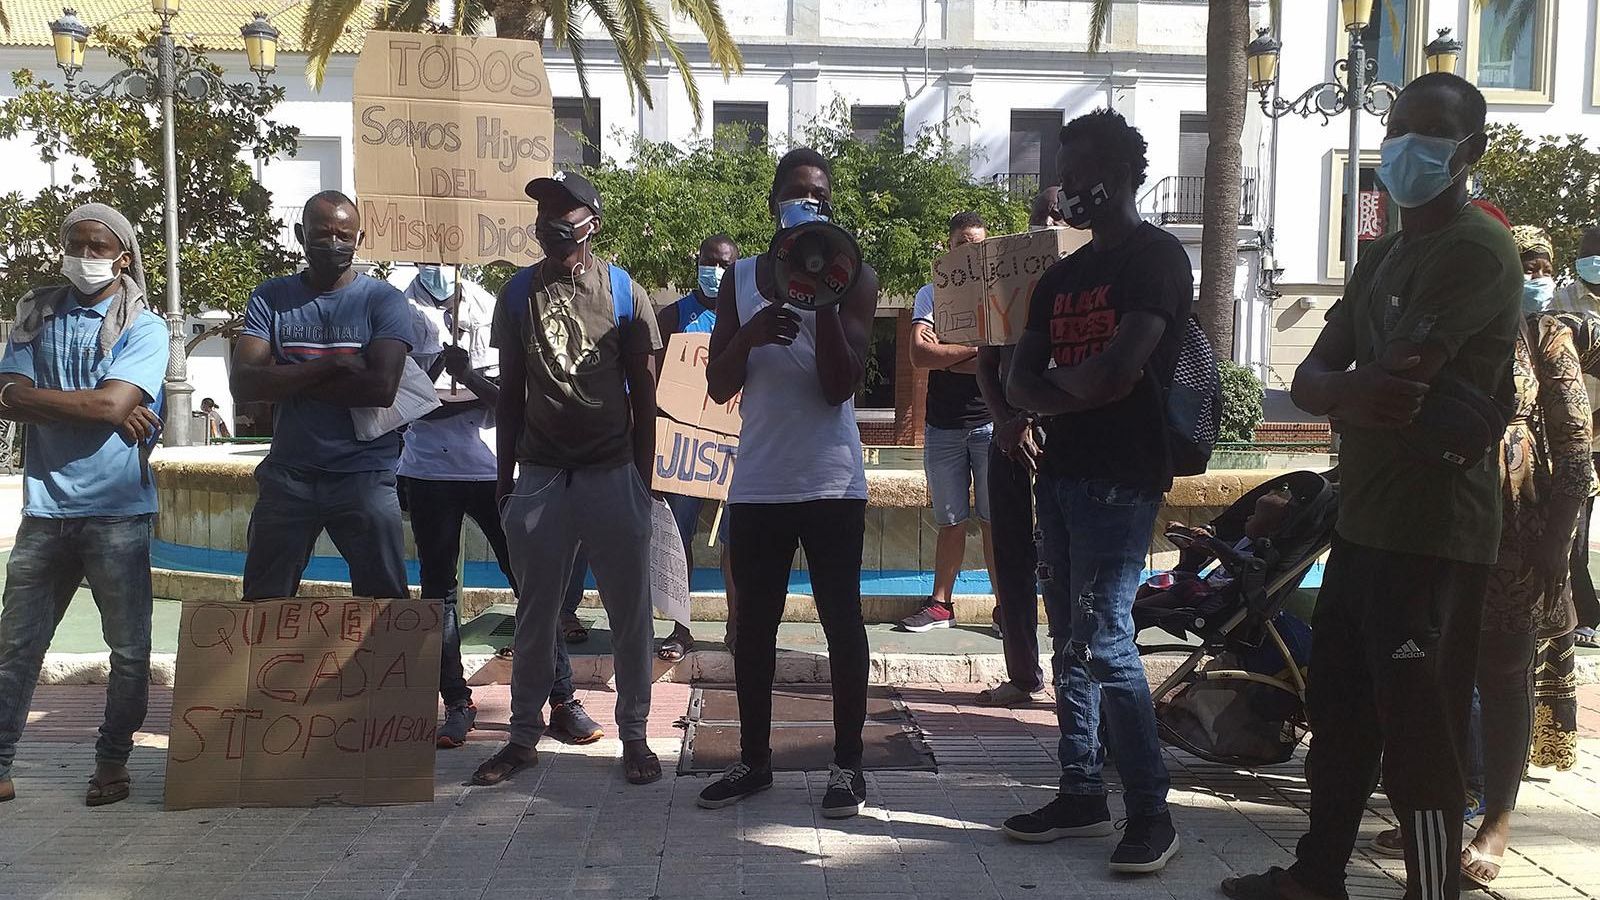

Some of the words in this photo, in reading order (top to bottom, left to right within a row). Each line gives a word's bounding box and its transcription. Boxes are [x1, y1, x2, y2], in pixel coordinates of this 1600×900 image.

[389, 40, 541, 97] TODOS
[430, 167, 487, 198] DEL
[788, 288, 815, 303] CGT
[1053, 284, 1112, 316] BLACK
[281, 324, 362, 340] ORIGINAL
[1052, 315, 1110, 340] LIVES
[190, 601, 442, 654] QUEREMOS
[1391, 650, 1425, 659] adidas
[256, 649, 408, 706] CASA
